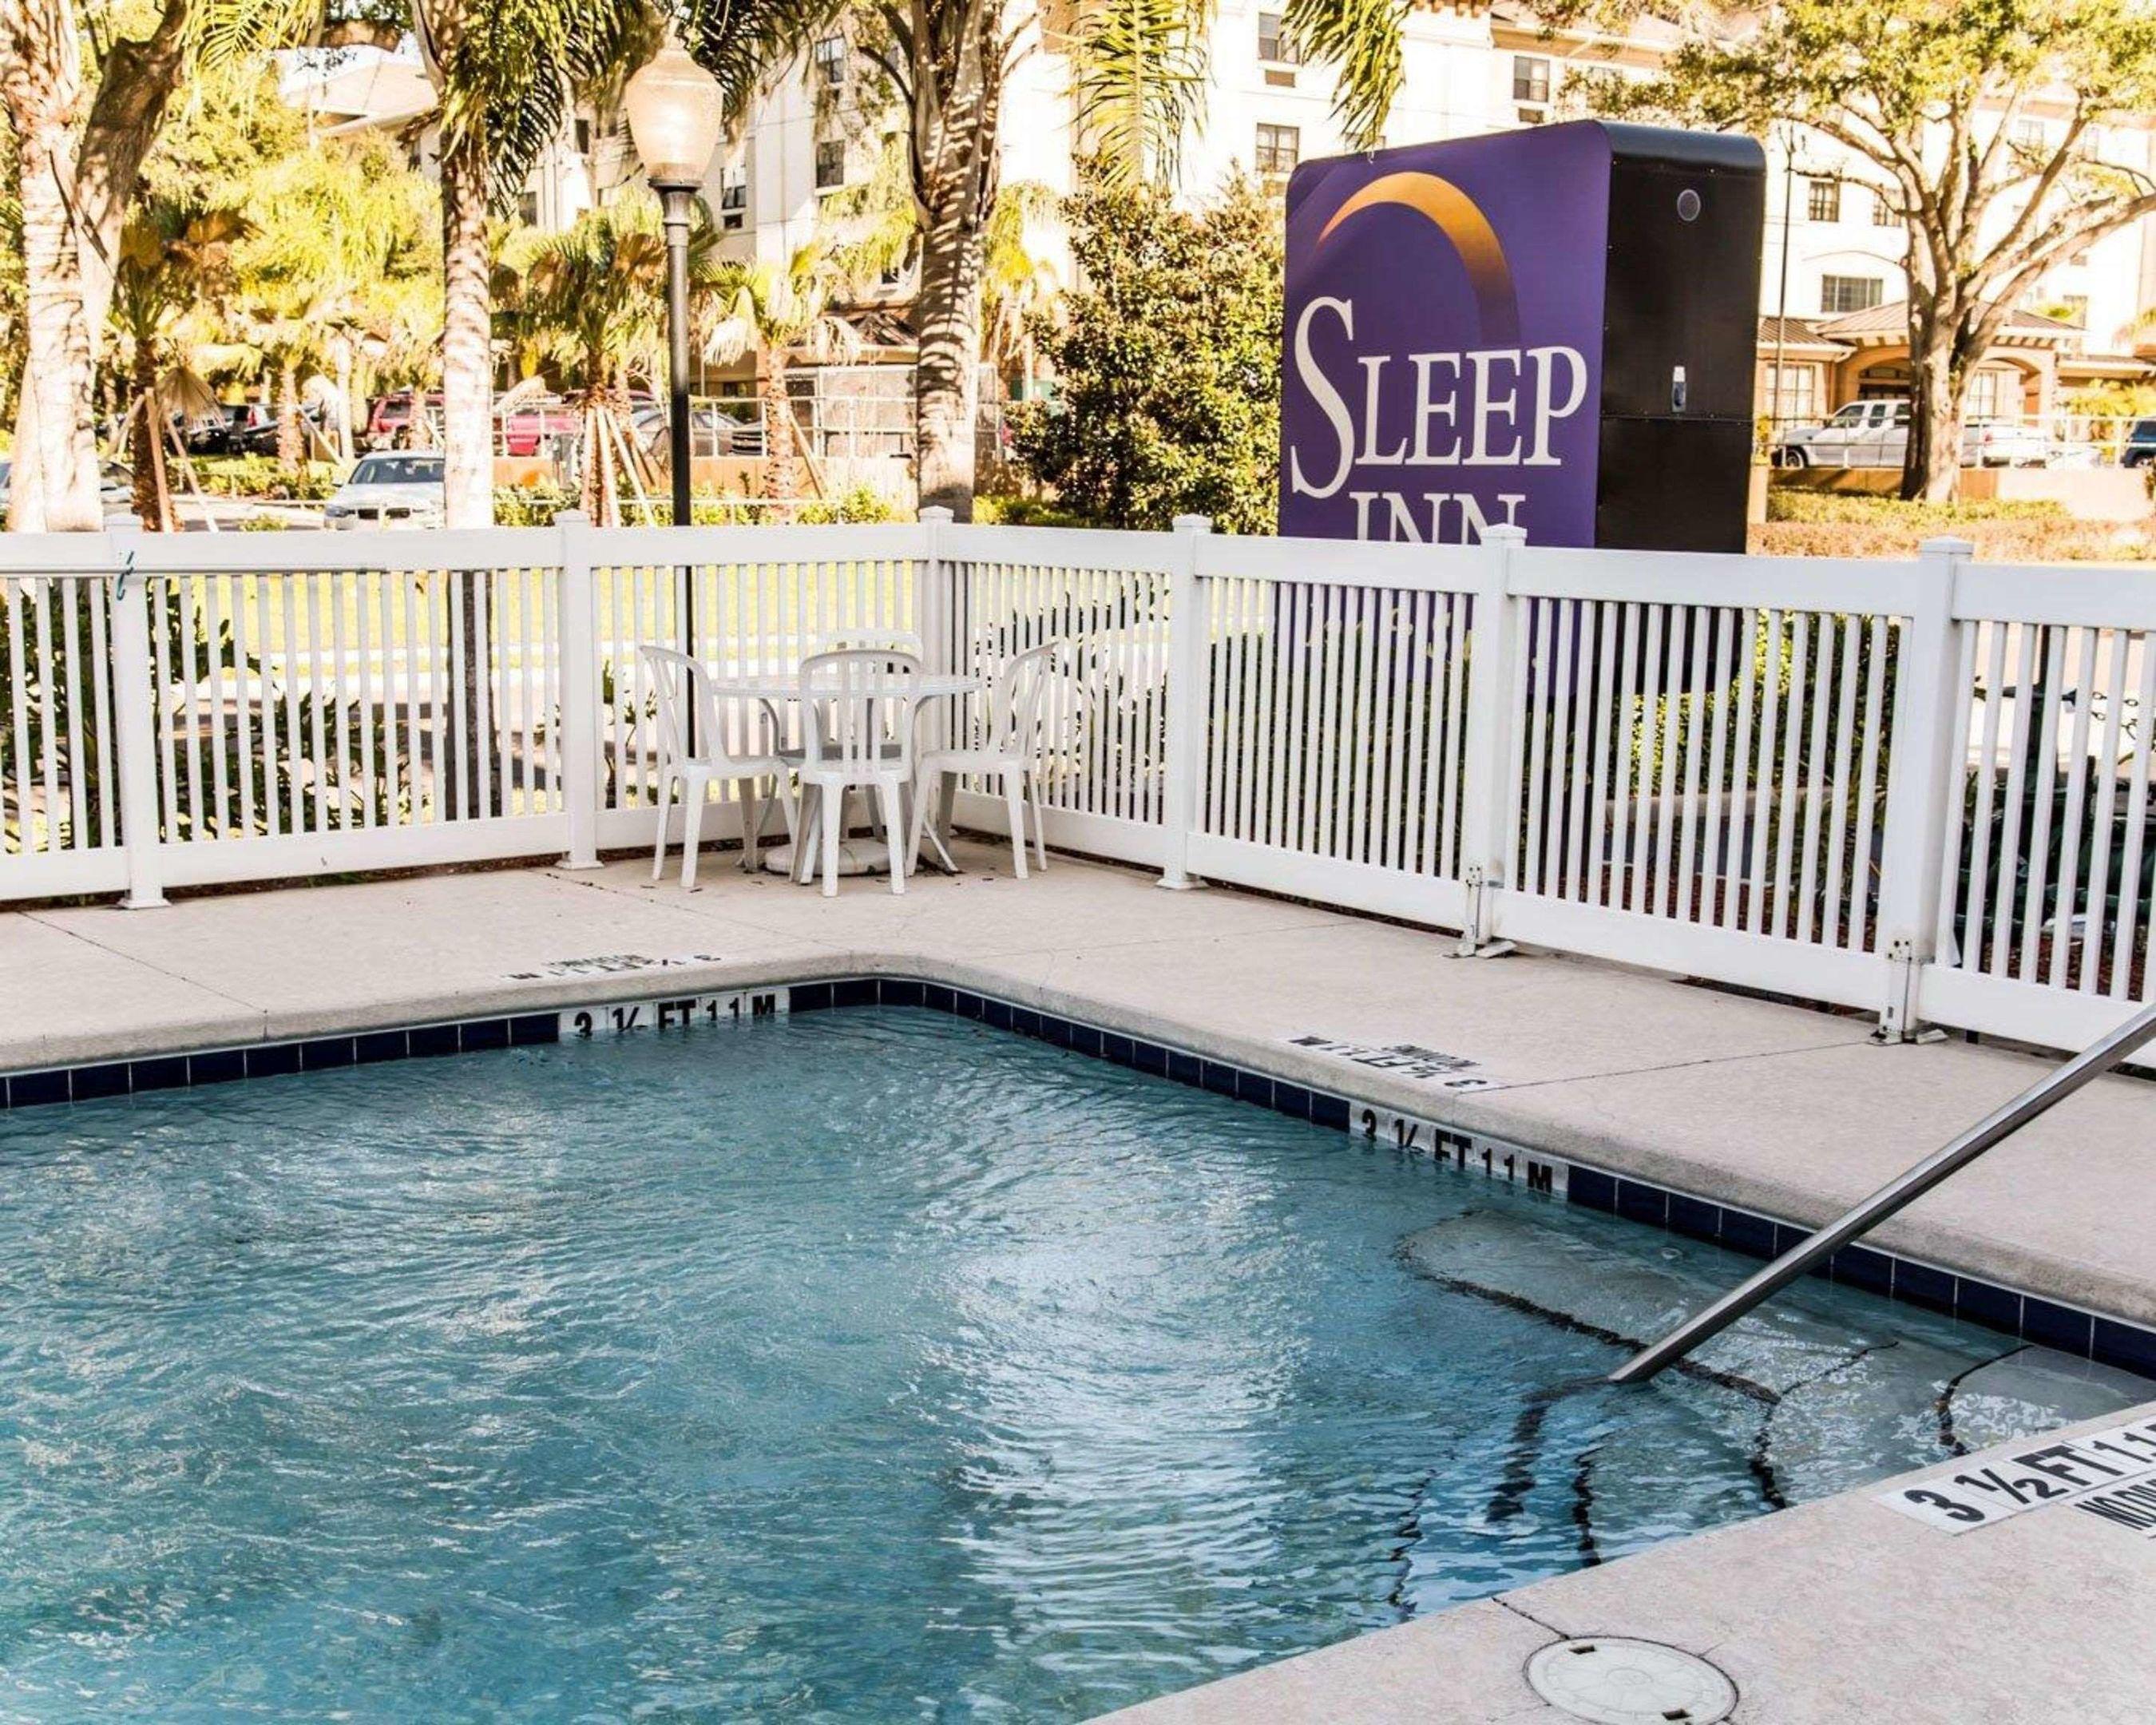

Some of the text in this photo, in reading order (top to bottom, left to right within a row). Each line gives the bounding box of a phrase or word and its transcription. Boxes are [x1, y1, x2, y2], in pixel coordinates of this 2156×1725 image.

[1290, 296, 1587, 499] SLEEP
[658, 999, 696, 1029] FT
[752, 994, 775, 1016] M
[1435, 1128, 1472, 1168] FT
[1528, 1161, 1552, 1192] M
[1904, 1489, 1985, 1522] 3
[2011, 1445, 2126, 1486] FT
